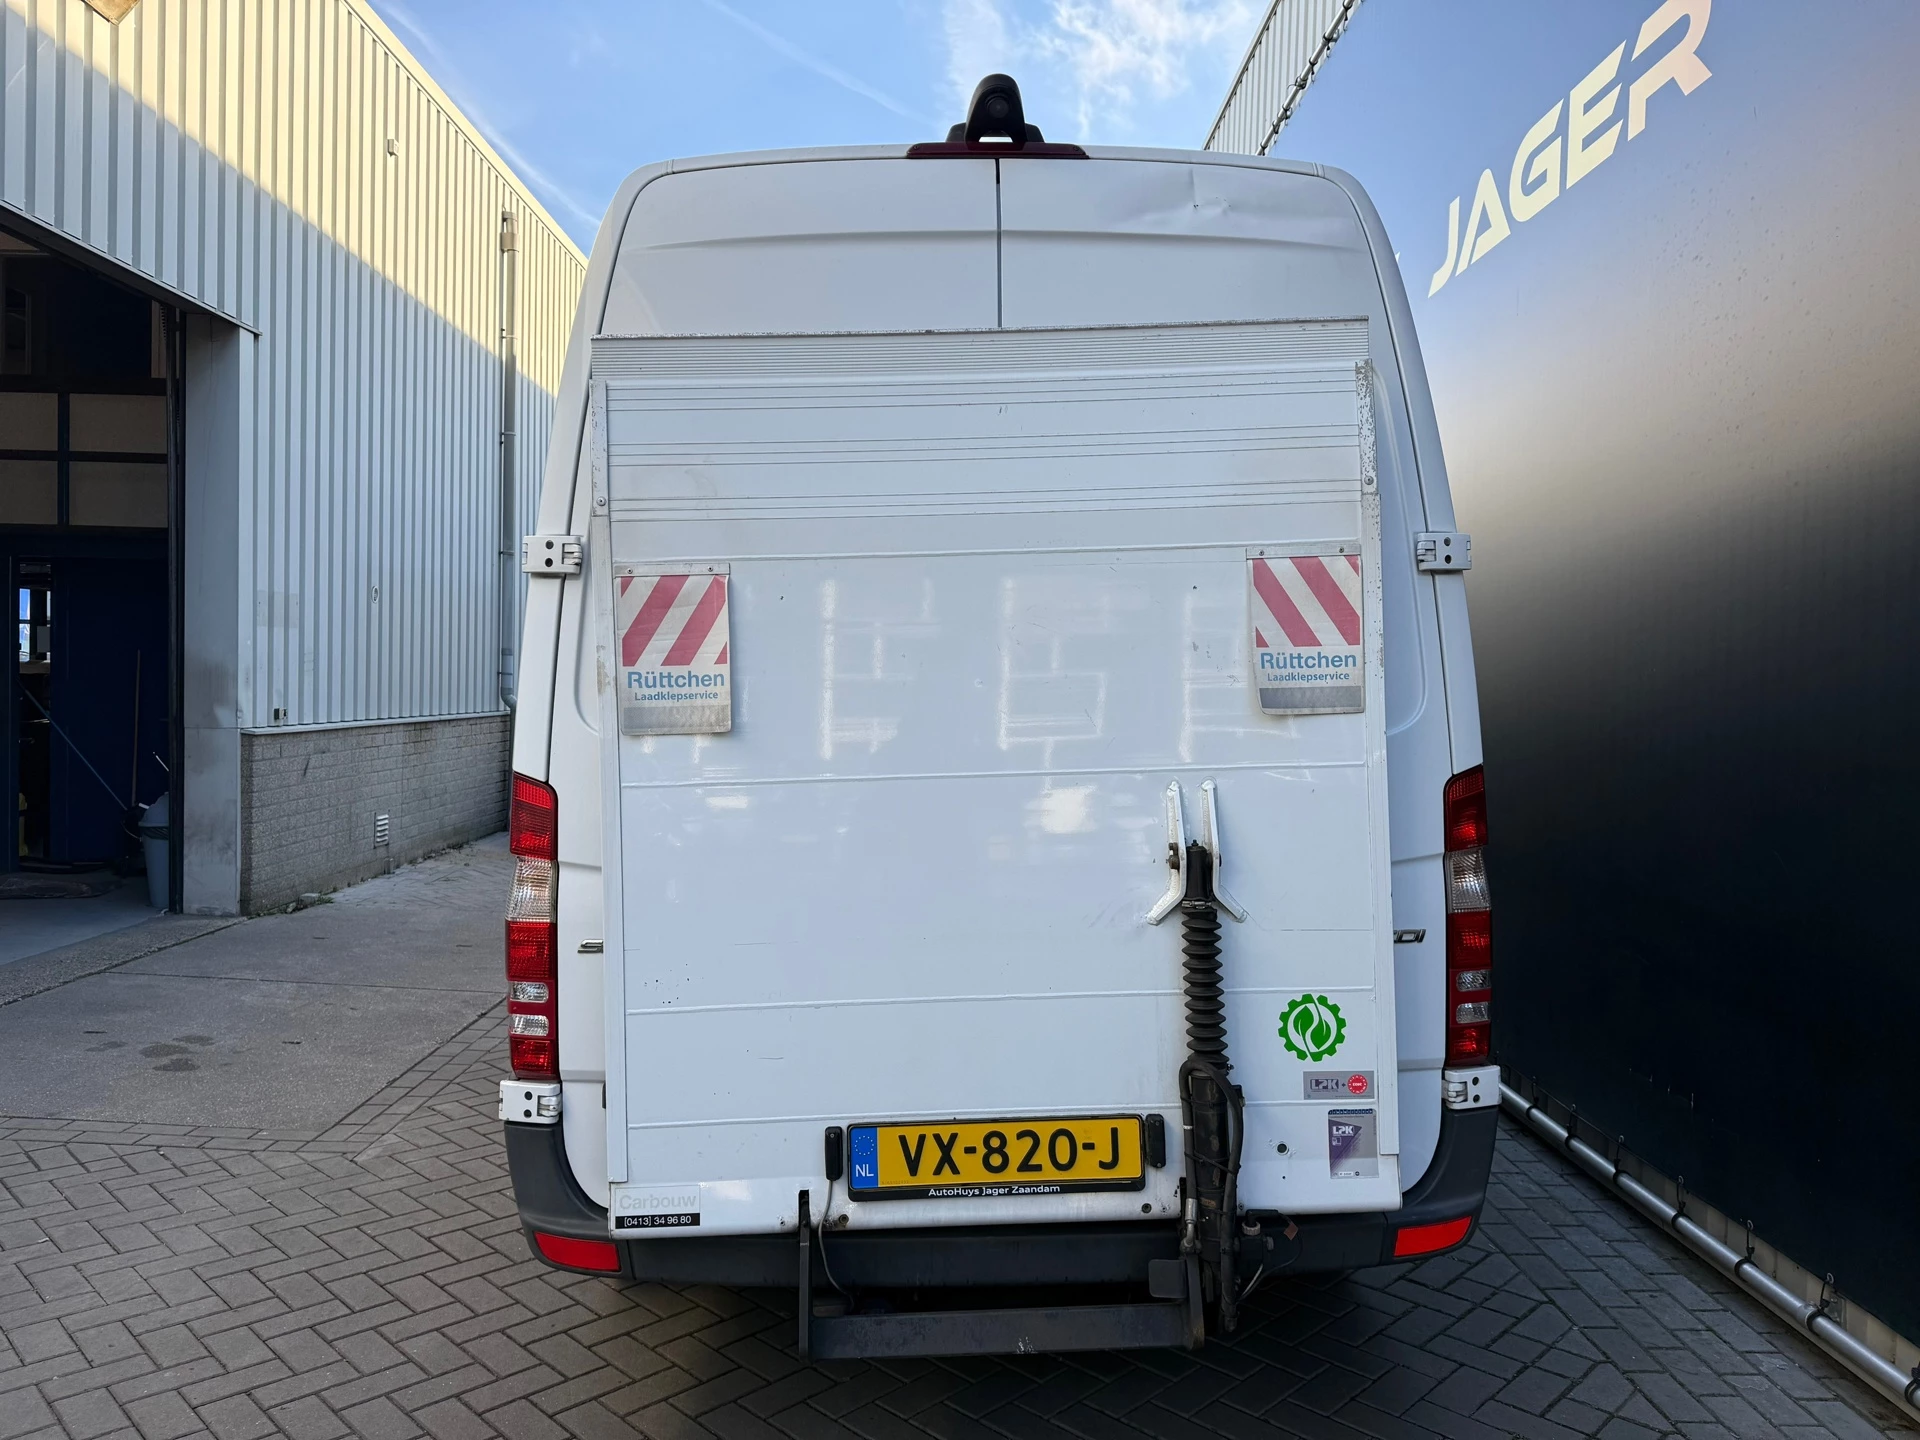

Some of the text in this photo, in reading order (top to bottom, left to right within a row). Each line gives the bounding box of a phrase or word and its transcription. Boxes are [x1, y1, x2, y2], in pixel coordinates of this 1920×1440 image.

[1427, 0, 1713, 299] JAGER
[1260, 651, 1357, 669] Rüttchen
[627, 670, 725, 689] Rüttchen
[1267, 670, 1350, 683] Laadklepservice
[634, 690, 719, 703] Laadklepservice
[897, 1126, 1120, 1178] VX-820-J
[855, 1163, 875, 1178] NL
[928, 1184, 1061, 1198] AutoHuys Jager Zaandam
[619, 1194, 697, 1210] Carbouw
[654, 1216, 665, 1225] 34
[667, 1215, 679, 1224] 96
[680, 1215, 692, 1224] 80
